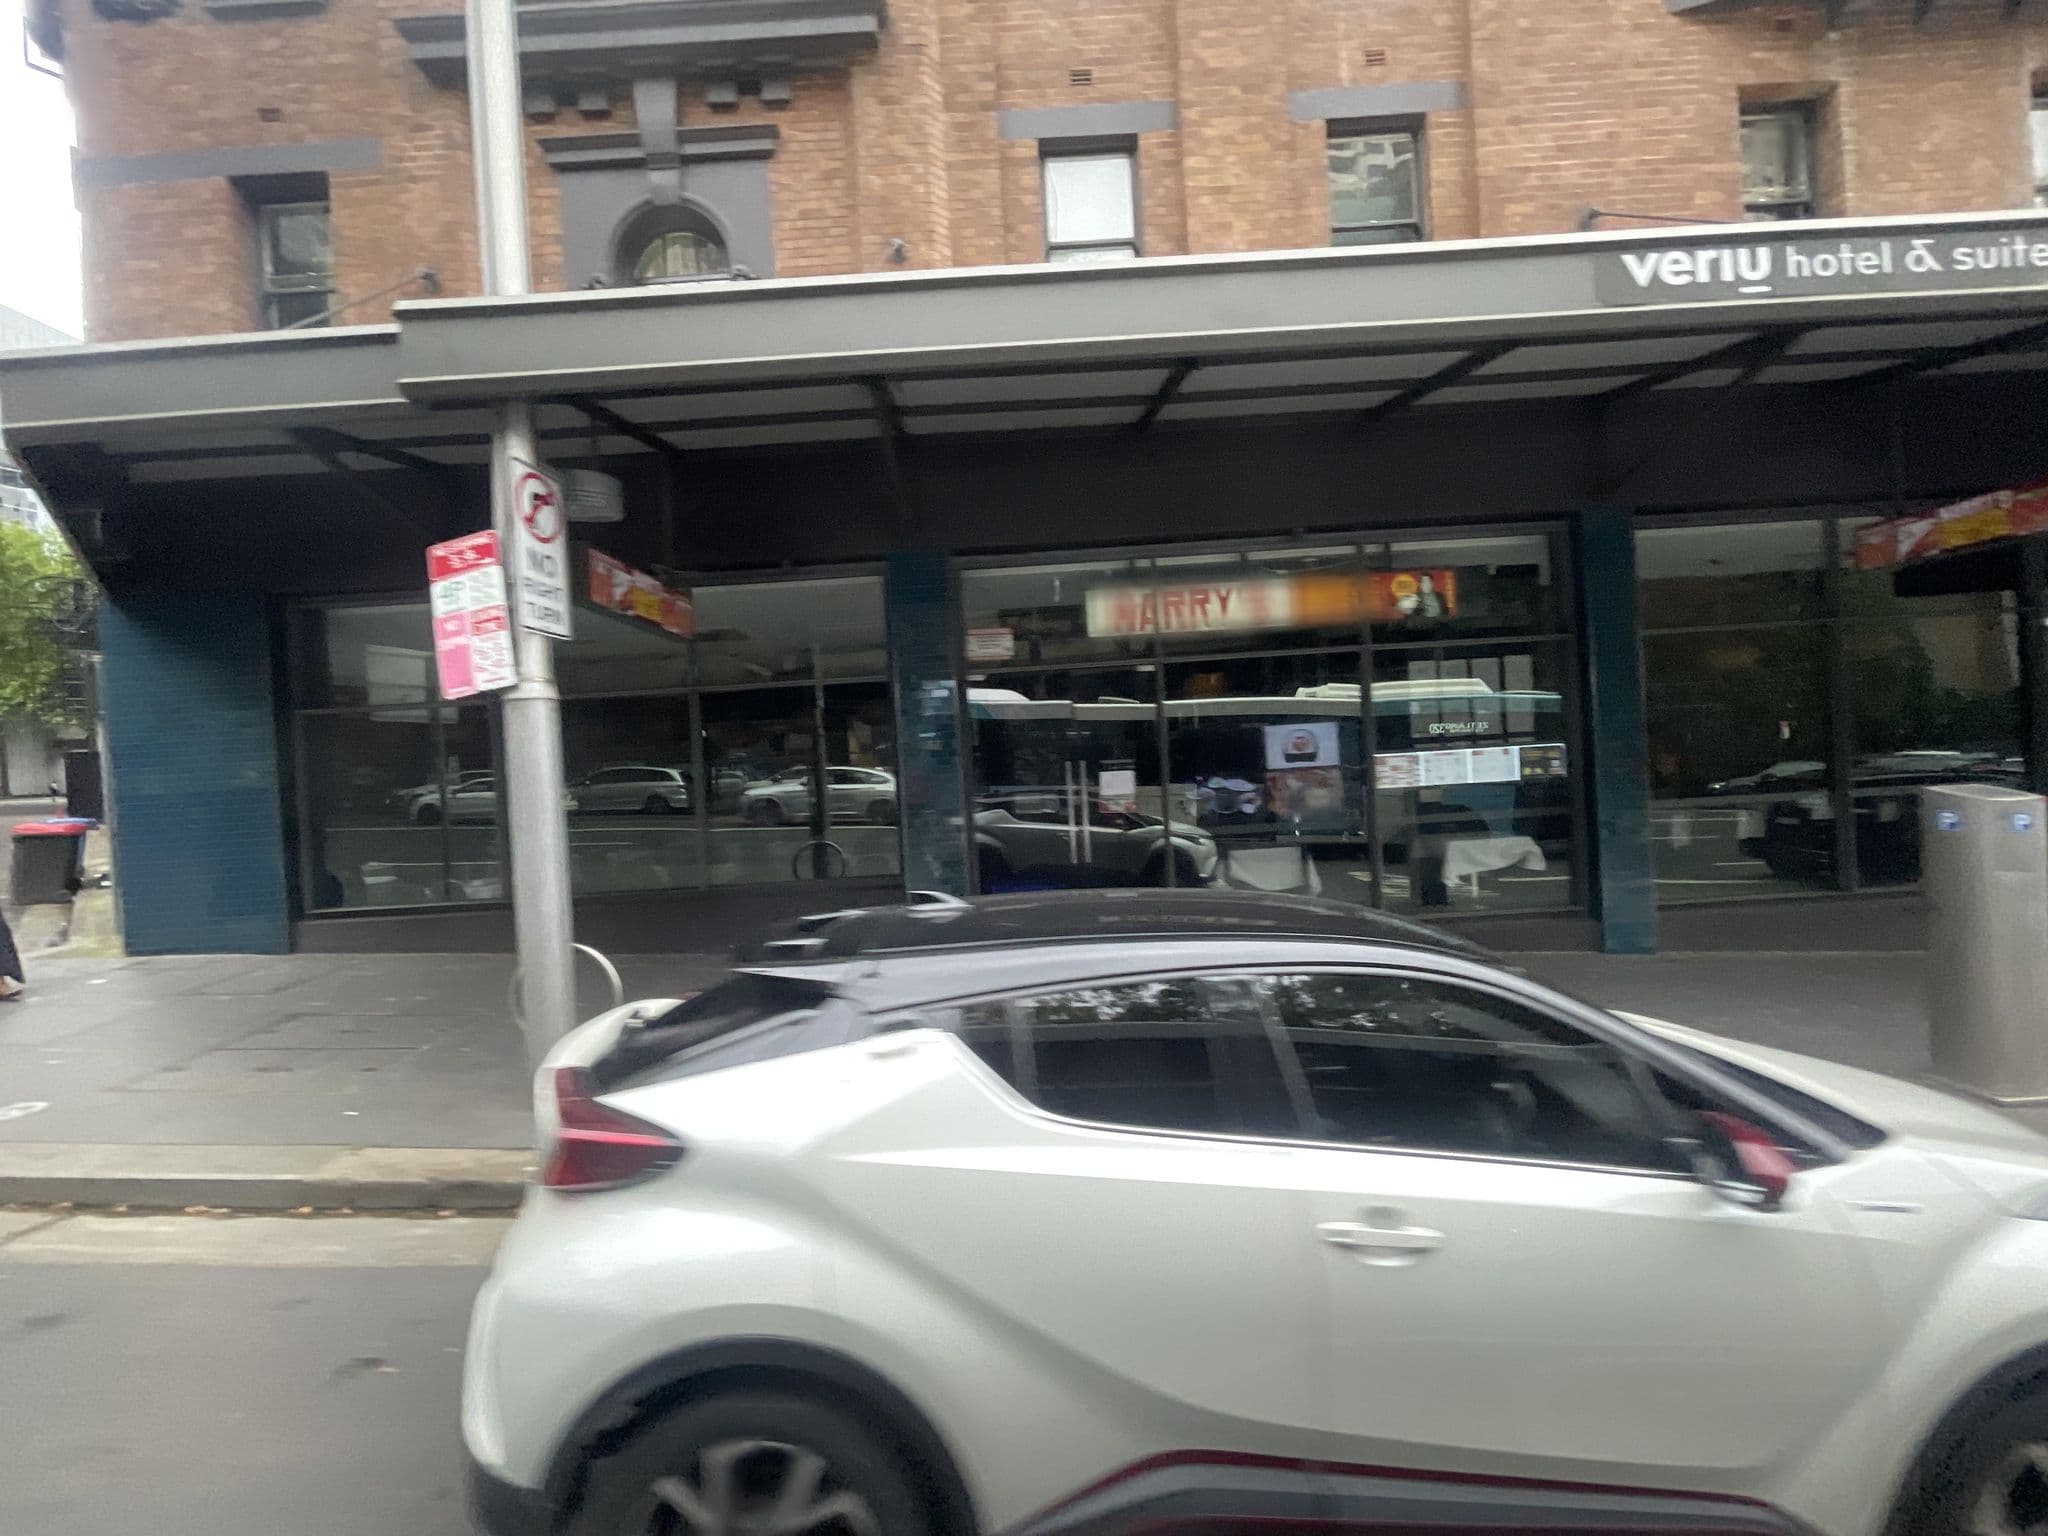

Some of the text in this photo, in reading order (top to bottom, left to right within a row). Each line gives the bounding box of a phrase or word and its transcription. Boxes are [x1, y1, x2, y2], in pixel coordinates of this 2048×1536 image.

[1785, 241, 1893, 278] hotel
[1904, 239, 1944, 273] &
[526, 547, 560, 579] NO
